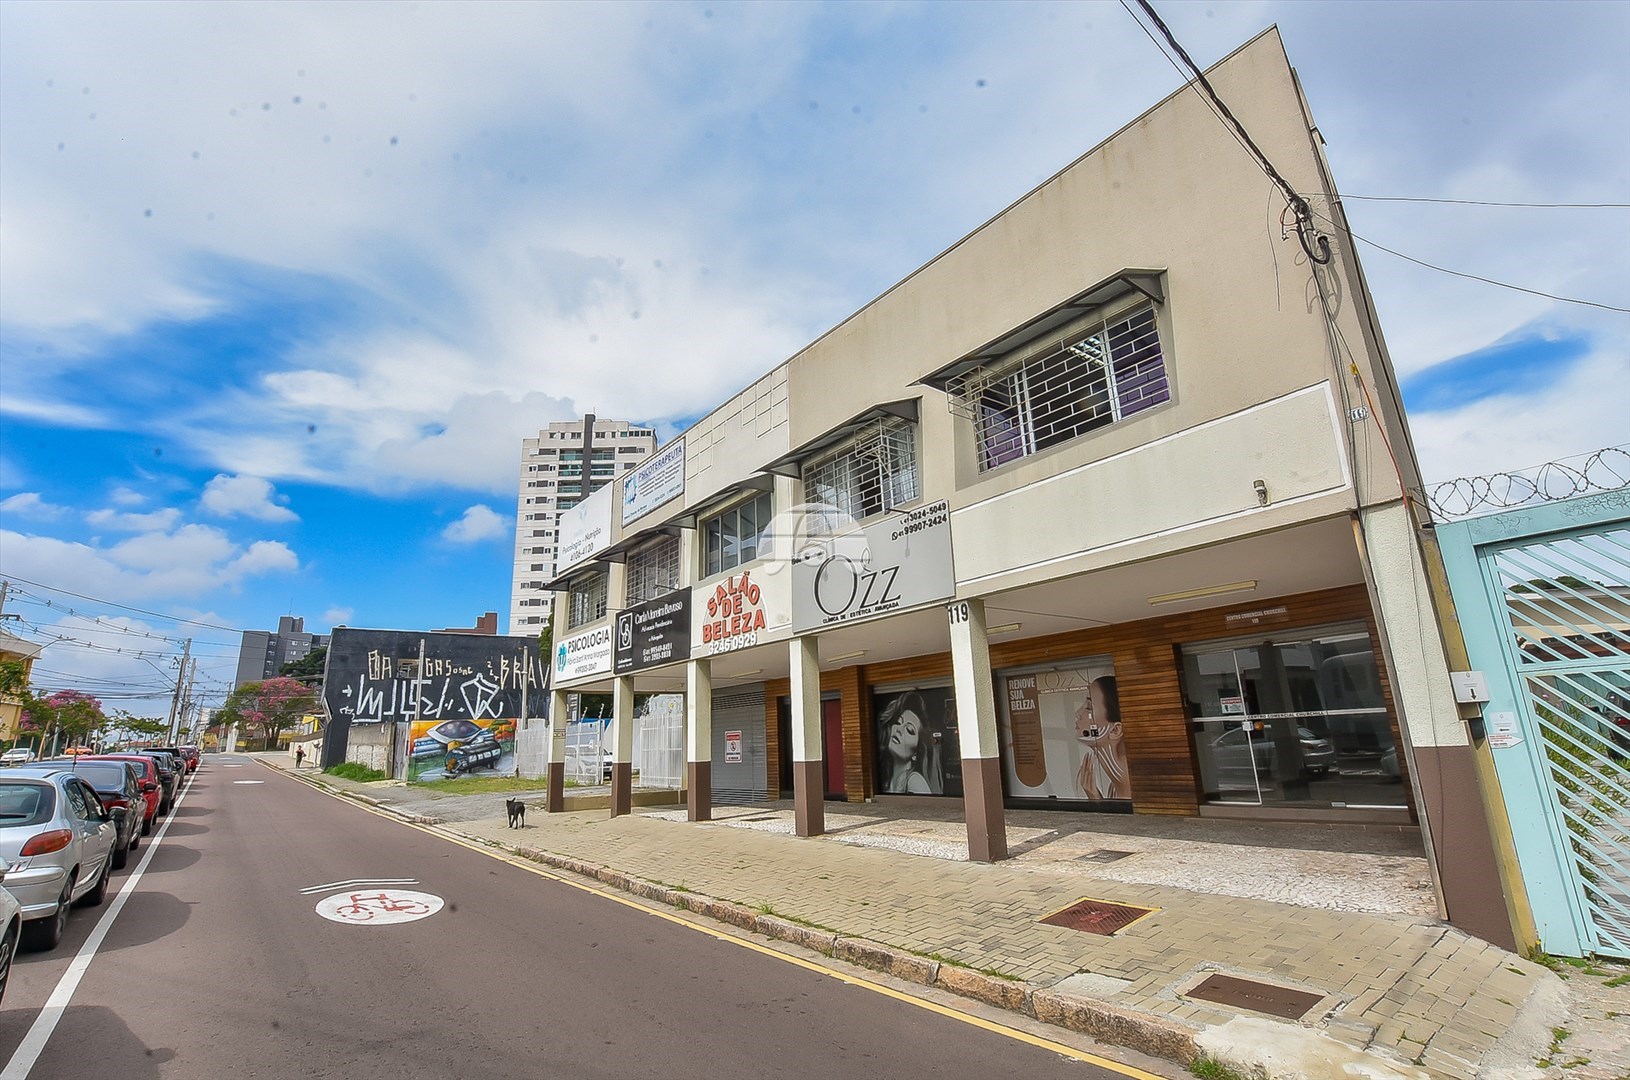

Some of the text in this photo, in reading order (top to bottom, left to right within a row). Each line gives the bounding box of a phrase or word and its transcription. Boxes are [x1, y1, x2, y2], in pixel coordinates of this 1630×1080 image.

[638, 445, 683, 480] PSICOTERAPEUTA
[909, 502, 947, 522] 3024-5049
[904, 513, 948, 535] 99907-2424
[707, 571, 761, 618] SALÃO
[814, 554, 902, 616] Ozz
[721, 594, 743, 618] DE
[948, 603, 969, 625] 119
[703, 609, 766, 644] BELEZA
[567, 629, 610, 655] PSICOLOGIA
[1008, 677, 1036, 690] RENOVE
[1010, 690, 1024, 700] SUA
[1010, 699, 1036, 711] BELEZA
